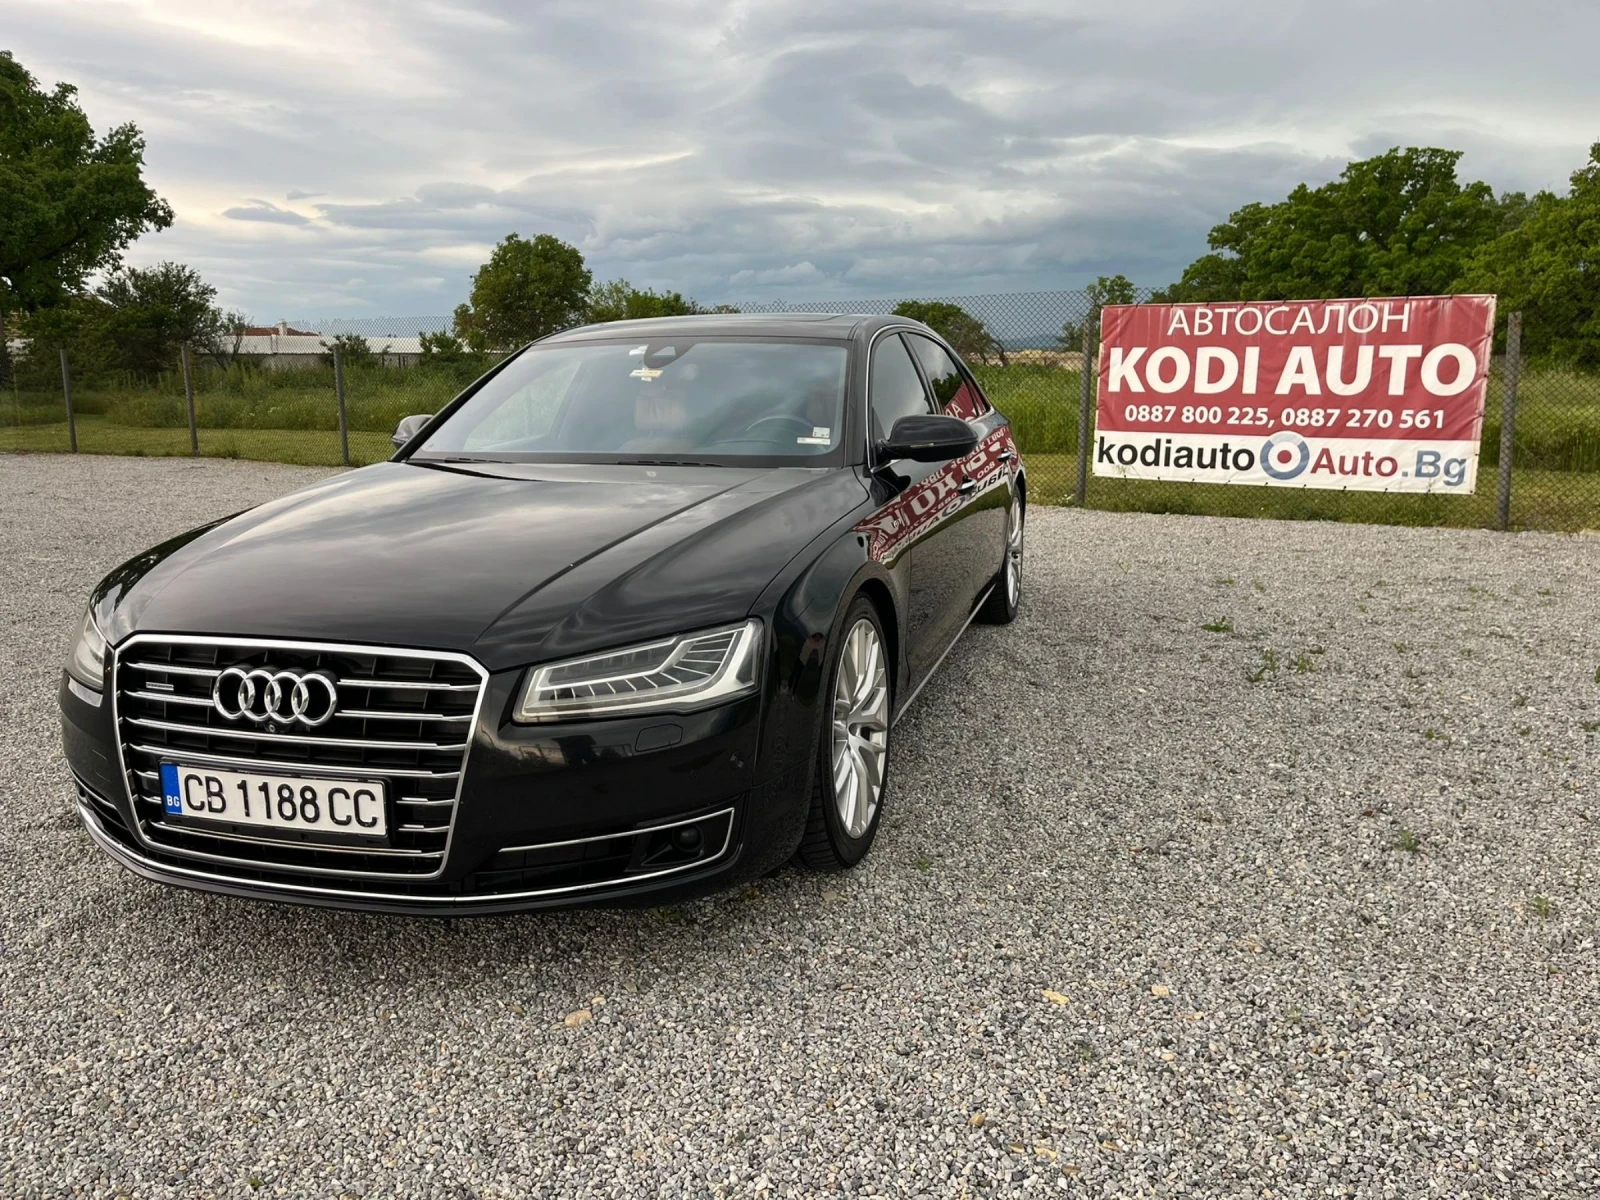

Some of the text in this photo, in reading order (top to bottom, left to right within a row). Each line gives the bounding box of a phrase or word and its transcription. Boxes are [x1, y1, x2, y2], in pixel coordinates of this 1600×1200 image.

[1167, 303, 1411, 336] АВТОСАЛОН
[1108, 343, 1477, 397] KODI AUTO
[1125, 404, 1445, 429] 0887 800 225, 0887 270 561
[1097, 436, 1255, 471] kodiauto
[166, 795, 180, 807] BG
[184, 773, 378, 828] CB 1188 CC
